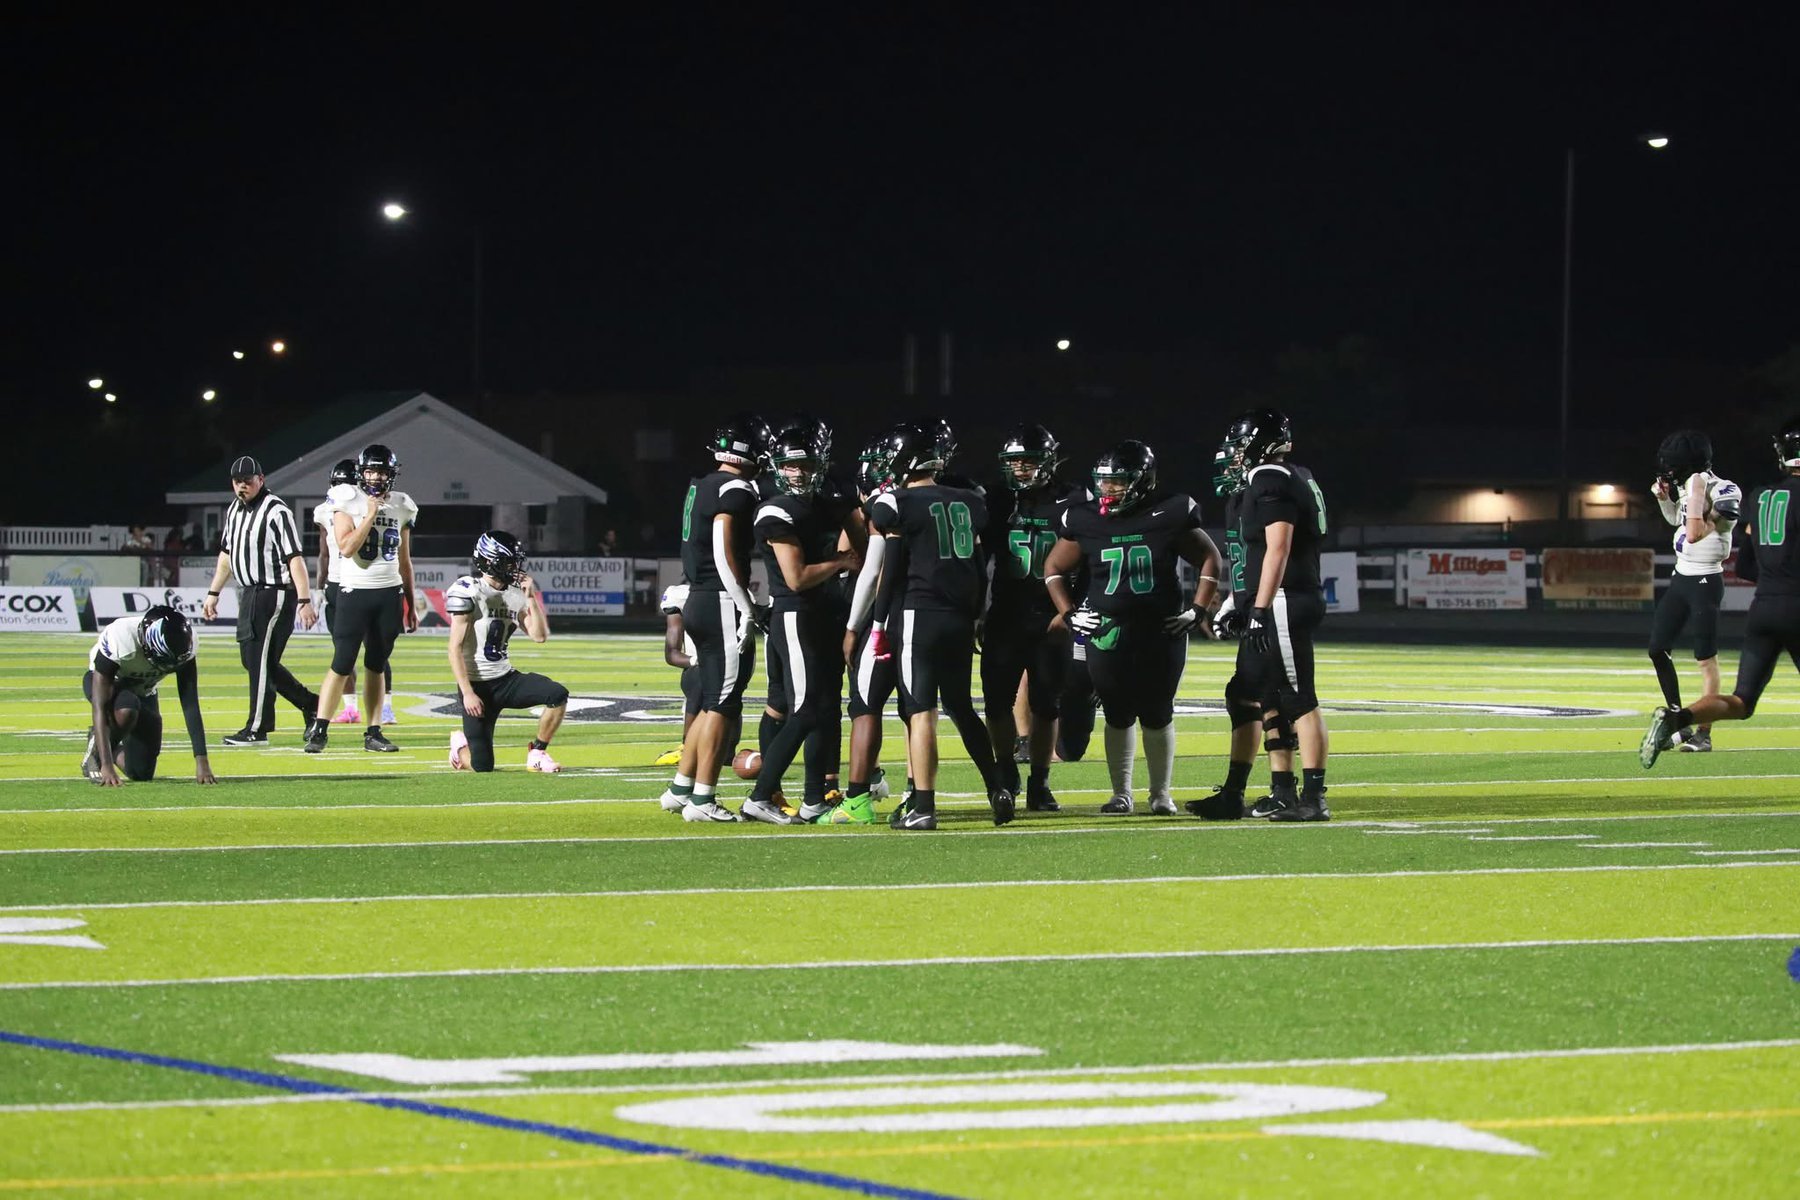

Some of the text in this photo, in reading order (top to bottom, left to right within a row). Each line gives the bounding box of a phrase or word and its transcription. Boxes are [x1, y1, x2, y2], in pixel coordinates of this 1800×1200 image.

[372, 516, 399, 528] GLES
[929, 501, 974, 560] 18
[1757, 489, 1791, 546] 10
[526, 560, 622, 573] AN BOULEVARD
[1009, 529, 1059, 580] 50
[1225, 542, 1248, 592] 2
[415, 570, 444, 582] man
[551, 575, 602, 588] COFFEE
[1101, 545, 1155, 606] 70
[24, 614, 68, 625] Services
